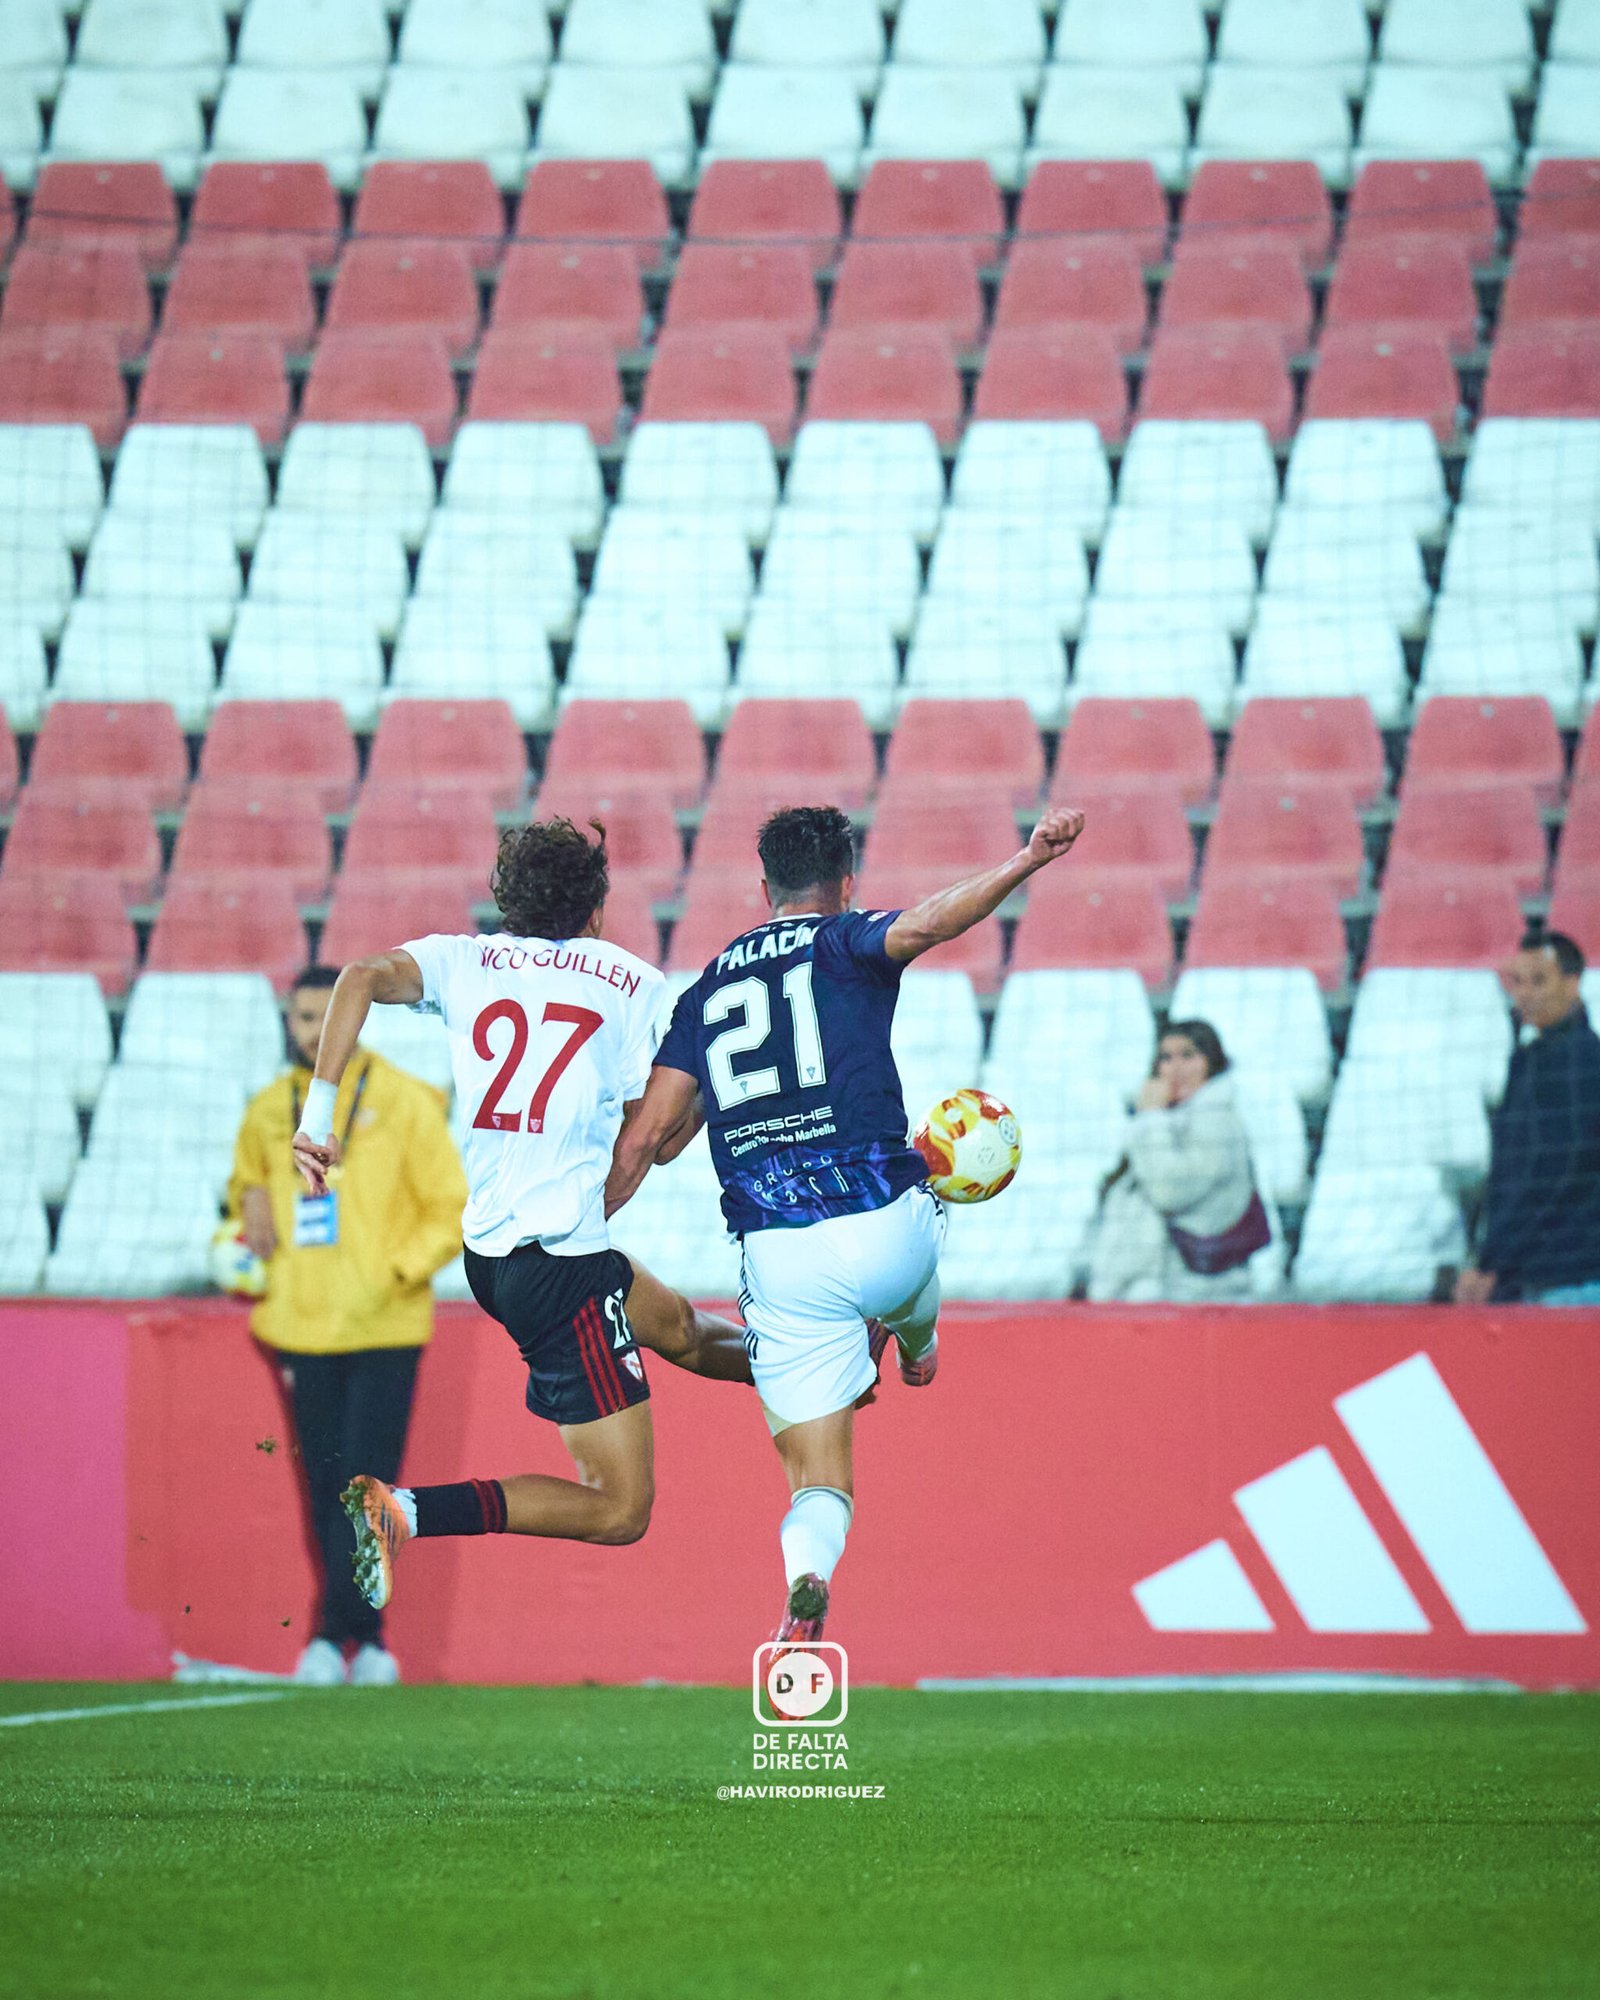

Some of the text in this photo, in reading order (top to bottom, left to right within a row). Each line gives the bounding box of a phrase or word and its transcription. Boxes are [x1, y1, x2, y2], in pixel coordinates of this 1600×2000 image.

[472, 998, 605, 1134] 27
[703, 961, 827, 1111] 21
[723, 1105, 834, 1144] PORSCHE
[795, 1122, 837, 1142] Marbella
